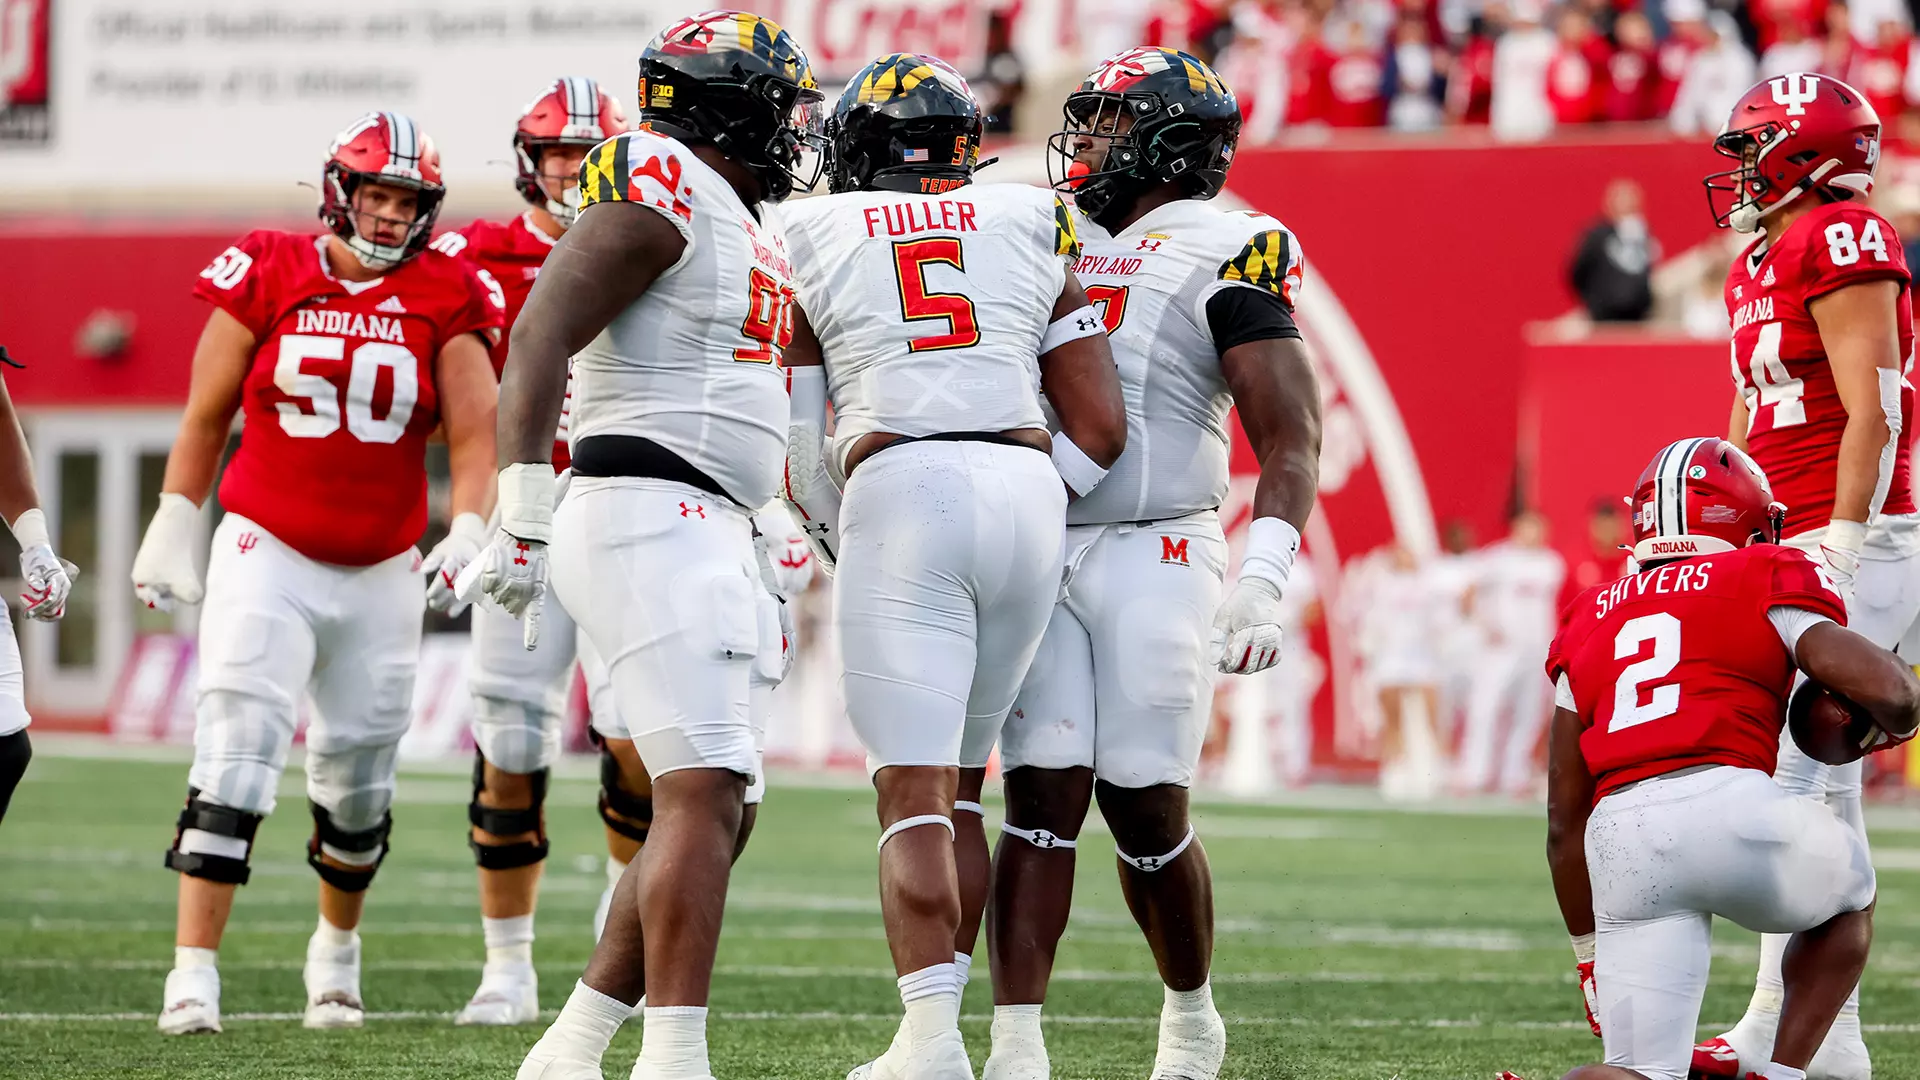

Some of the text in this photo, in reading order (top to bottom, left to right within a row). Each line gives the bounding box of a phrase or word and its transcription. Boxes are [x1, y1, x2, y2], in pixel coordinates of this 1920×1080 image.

[952, 136, 967, 166] 5
[863, 200, 978, 238] FULLER
[1824, 219, 1890, 267] 84
[200, 246, 253, 290] 50
[1070, 255, 1143, 276] ARYLAND
[891, 236, 981, 353] 5
[296, 309, 405, 343] INDIANA
[273, 334, 418, 444] 50
[1652, 541, 1698, 554] INDIANA
[1595, 562, 1713, 620] SHIVERS
[1607, 612, 1681, 734] 2
